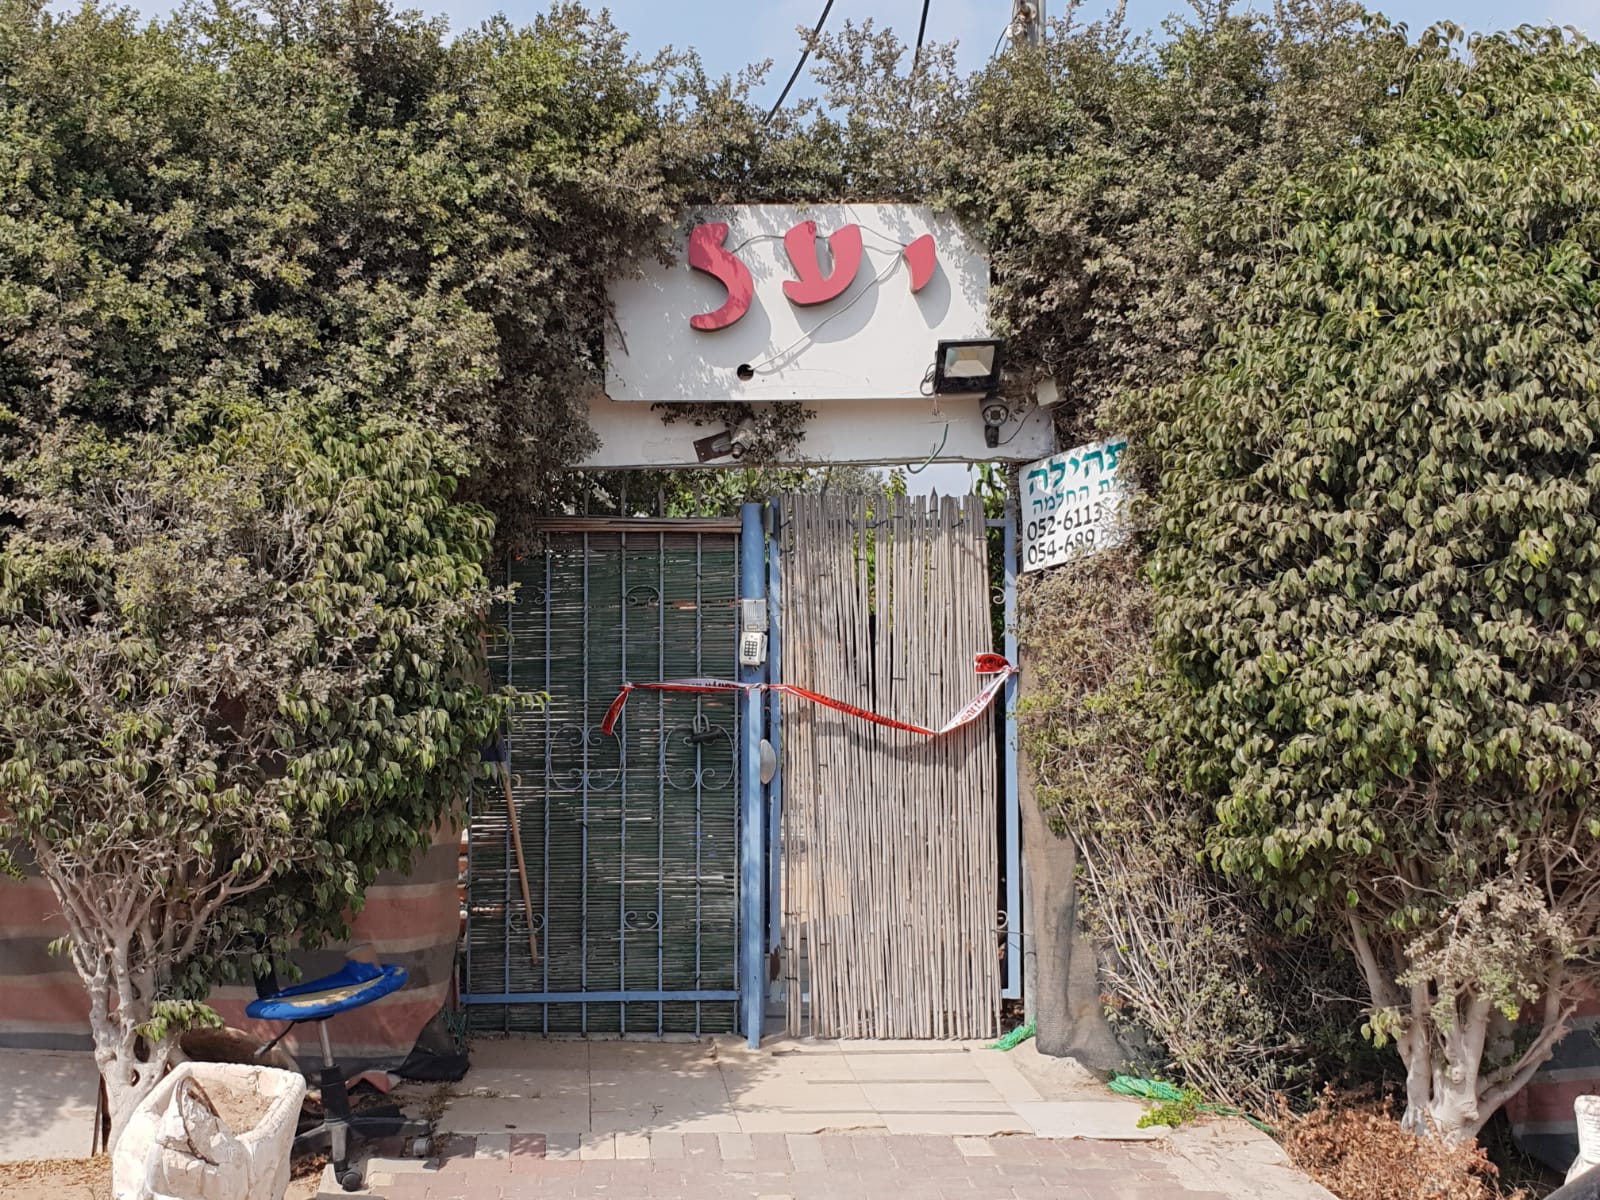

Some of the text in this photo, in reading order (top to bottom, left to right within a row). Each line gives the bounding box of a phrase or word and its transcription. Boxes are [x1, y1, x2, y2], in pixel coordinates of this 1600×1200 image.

[689, 220, 935, 331] יעל
[1032, 485, 1089, 515] החלמה
[1027, 502, 1102, 541] 052-6113
